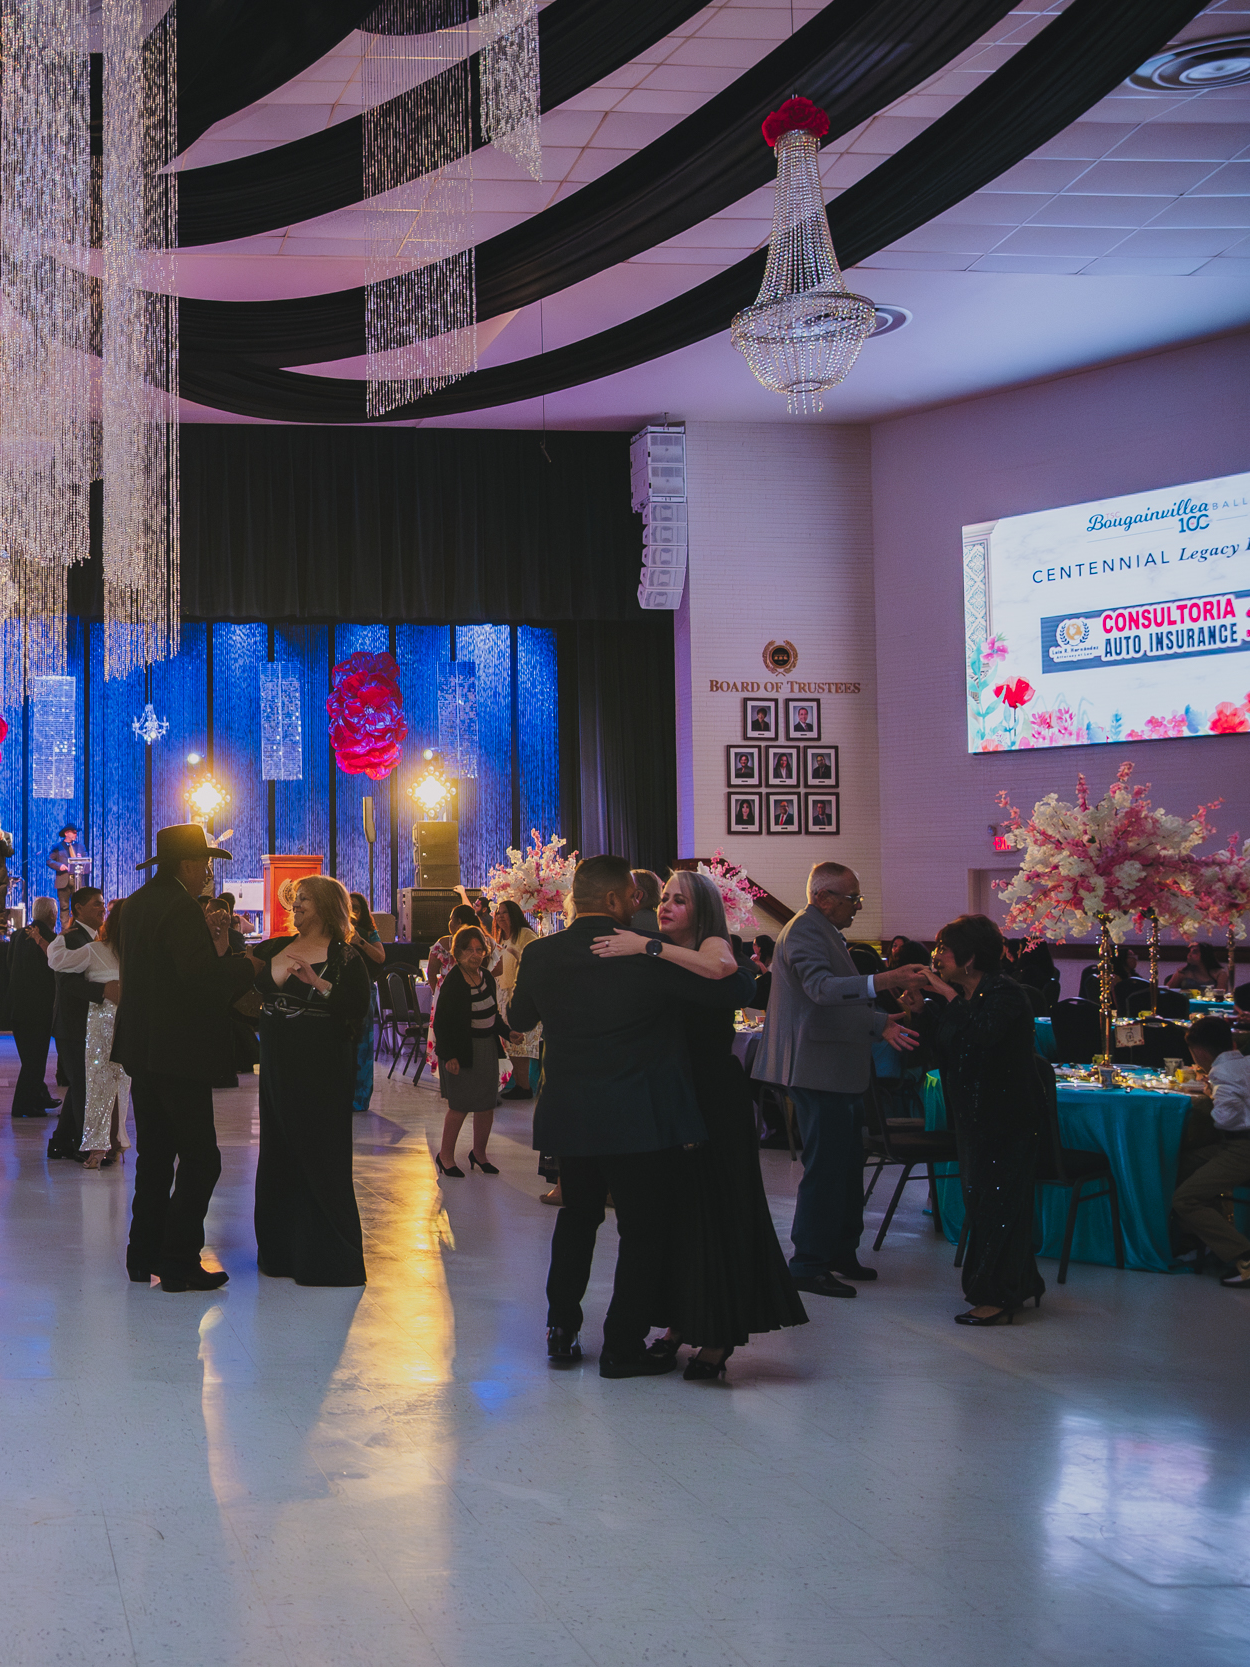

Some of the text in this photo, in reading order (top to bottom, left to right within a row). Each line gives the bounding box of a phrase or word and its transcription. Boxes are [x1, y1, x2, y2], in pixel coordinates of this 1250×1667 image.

[1086, 497, 1248, 532] Bougainvillea BALL
[1105, 511, 1121, 520] TSC
[1032, 550, 1170, 584] CENTENNIAL
[1177, 543, 1240, 563] Legacy
[1102, 597, 1236, 634] CONSULTORIA
[1104, 622, 1238, 658] AUTO INSURANCE
[709, 679, 861, 694] BOARD OF TRUSTEES
